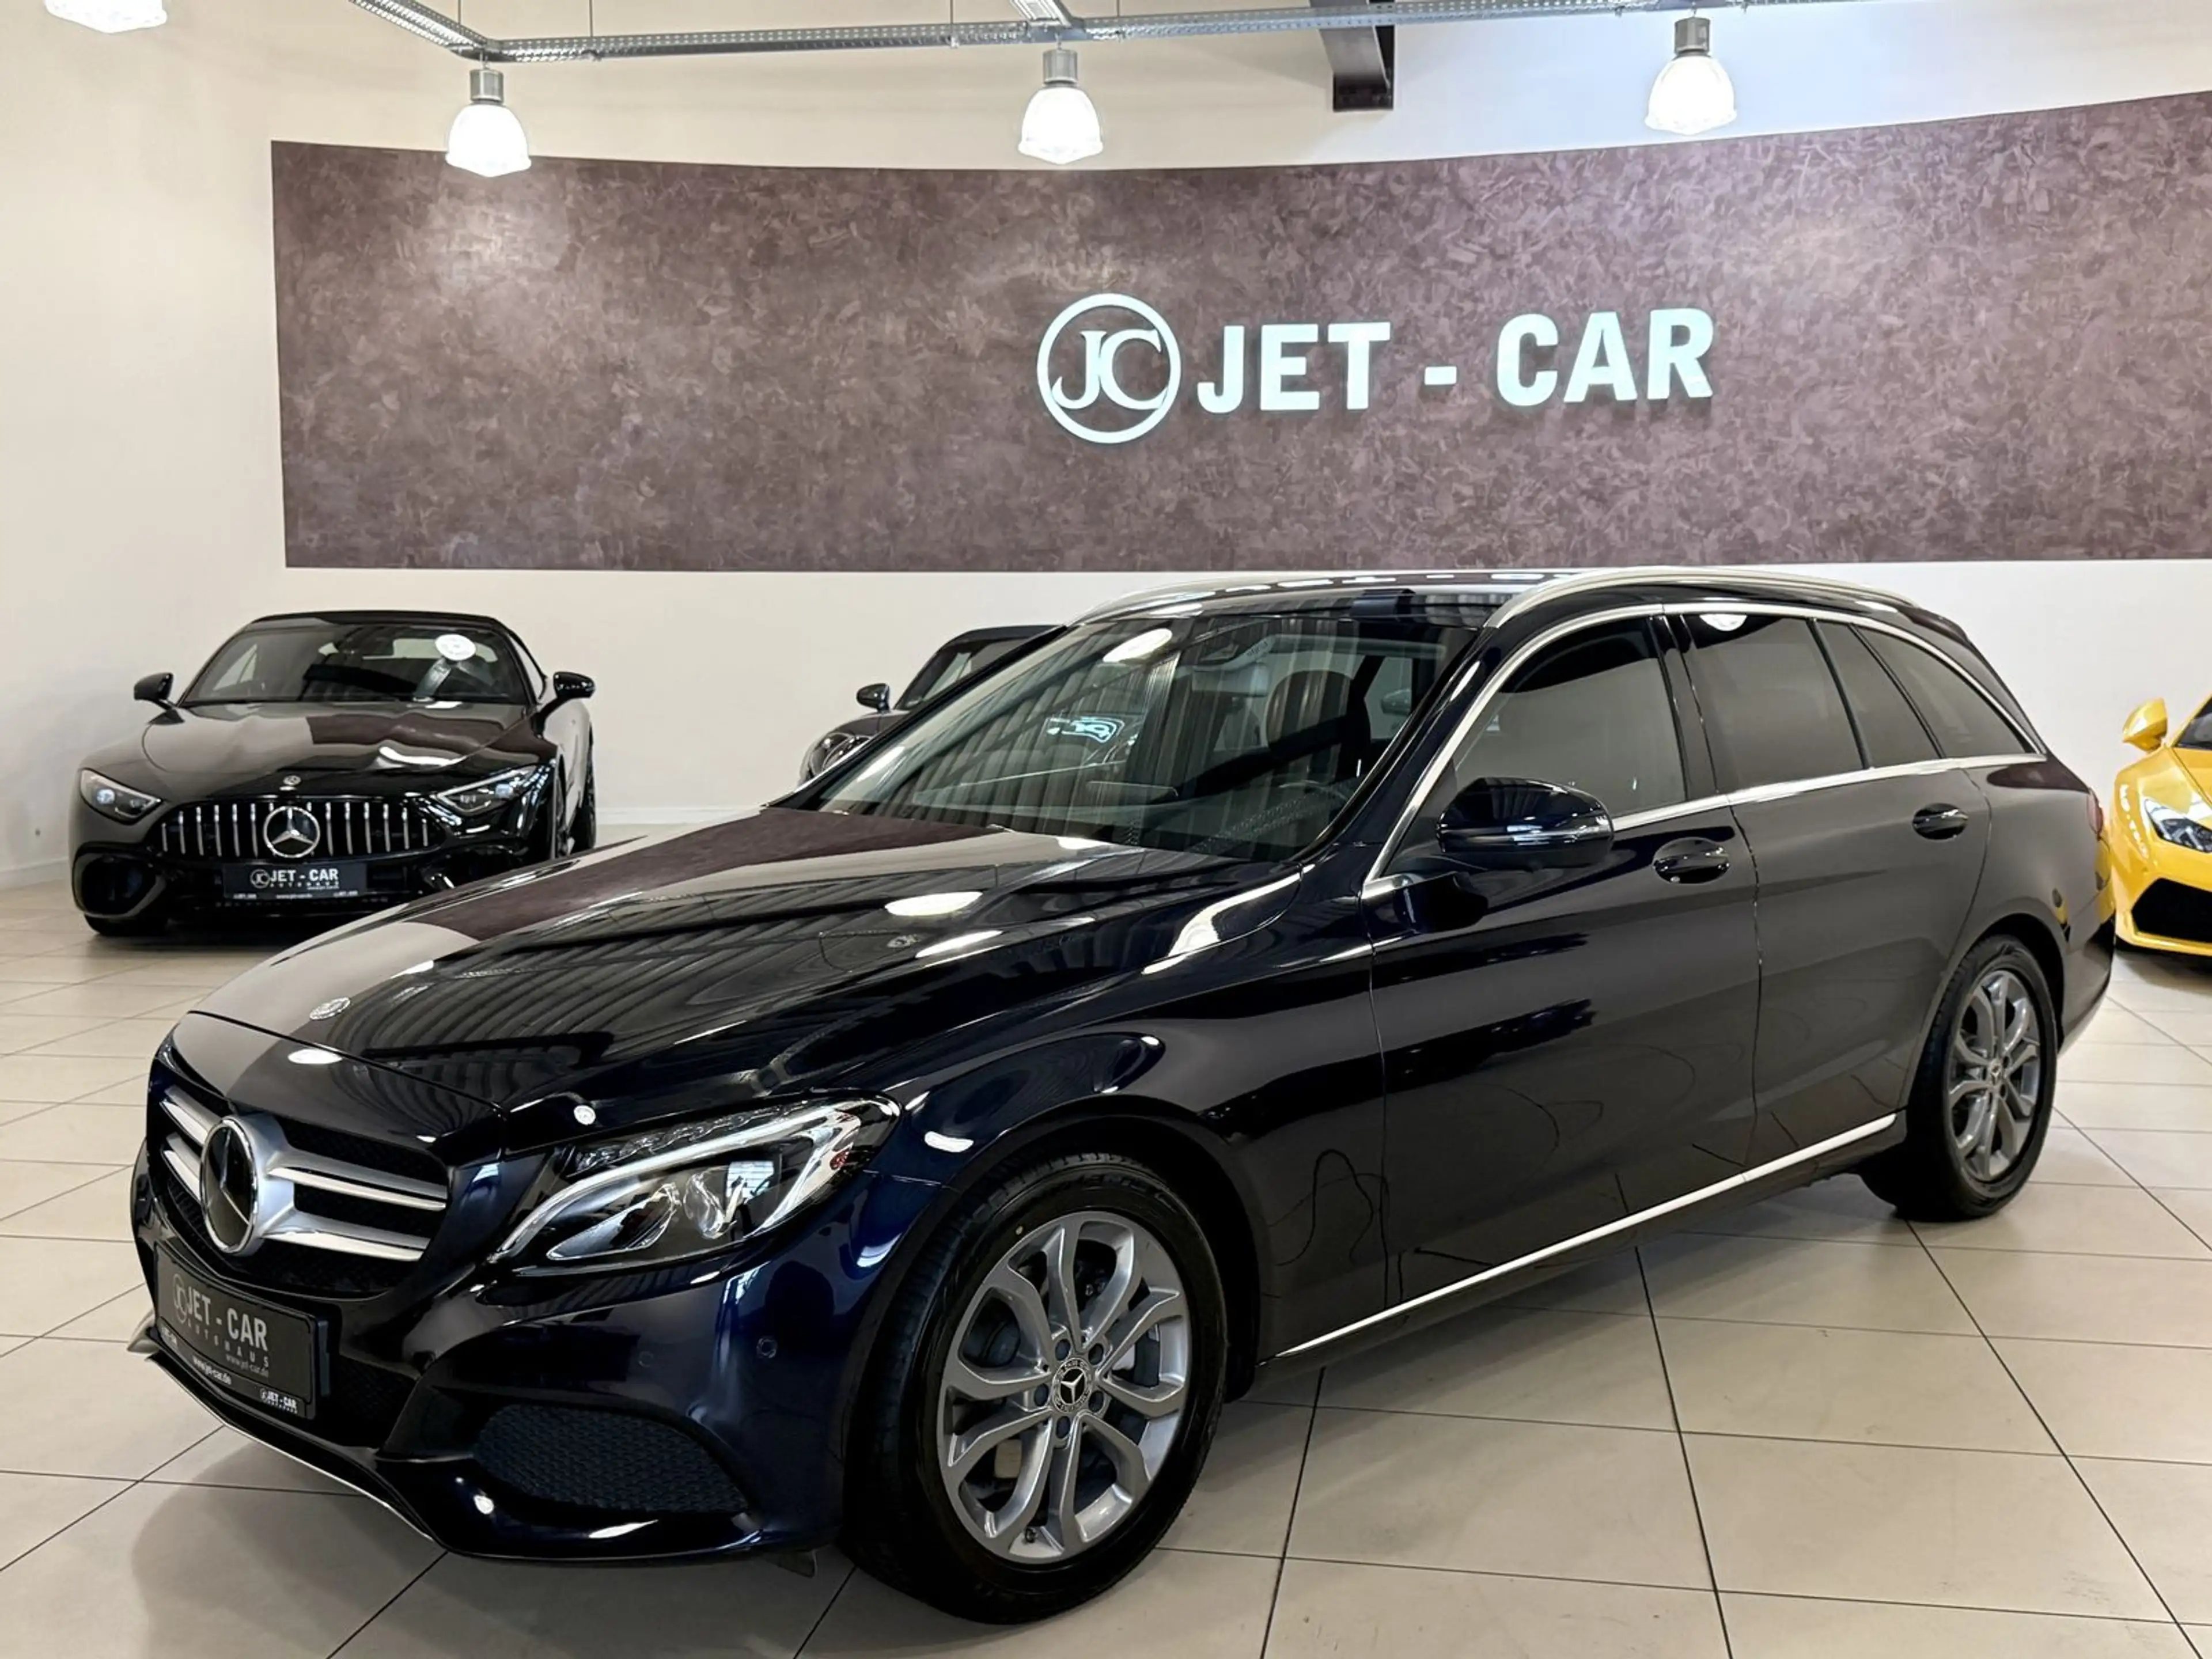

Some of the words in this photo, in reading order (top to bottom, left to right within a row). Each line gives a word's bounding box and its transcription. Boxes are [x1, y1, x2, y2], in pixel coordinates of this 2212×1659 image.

[1197, 321, 1391, 414] JET
[1425, 366, 1457, 385] -
[1498, 307, 1714, 406] CAR
[270, 870, 296, 881] JET
[309, 868, 339, 881] CAR
[187, 1286, 211, 1325] JET
[227, 1308, 268, 1351] CAR
